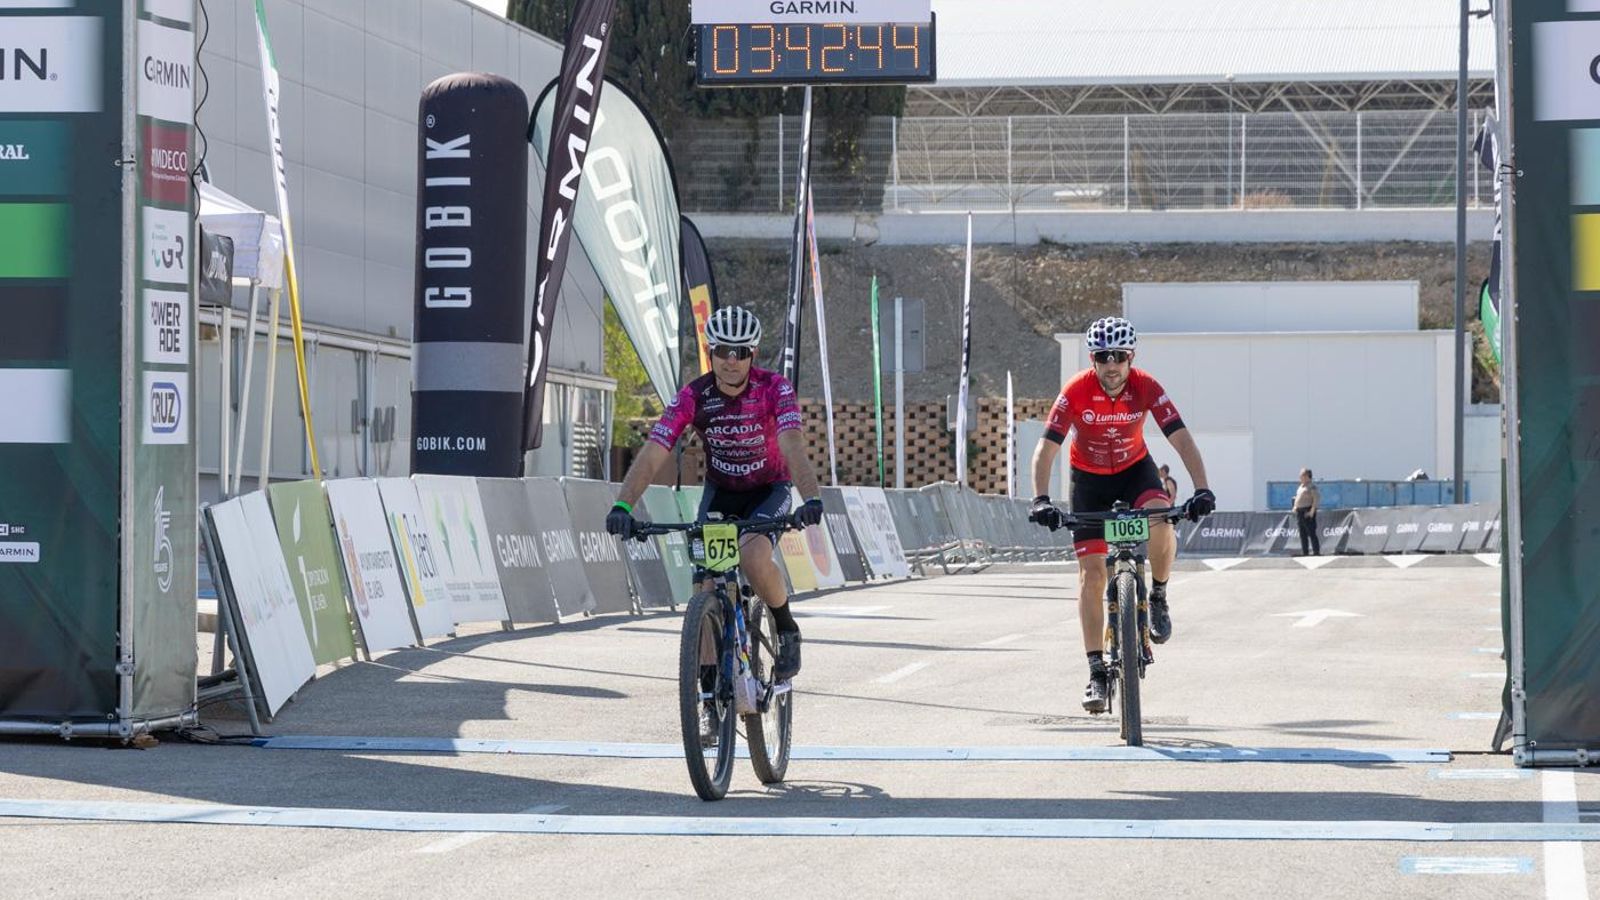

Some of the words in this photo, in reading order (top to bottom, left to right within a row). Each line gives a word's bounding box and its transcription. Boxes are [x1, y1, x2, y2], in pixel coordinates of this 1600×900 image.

[769, 1, 856, 15] GARMIN
[713, 24, 919, 73] 03:42:44
[144, 56, 190, 88] GRMIN
[425, 133, 472, 309] GOBIK
[159, 328, 180, 353] ADE
[705, 424, 763, 434] ARCADIA
[416, 436, 486, 451] GOBIK.COM
[1111, 520, 1143, 537] 1063
[1201, 527, 1245, 538] GARMIN
[1264, 527, 1299, 538] GARMI
[496, 534, 542, 568] GARMIN
[542, 528, 577, 562] GARMIN
[580, 531, 619, 562] GARMIN
[708, 538, 737, 560] 675
